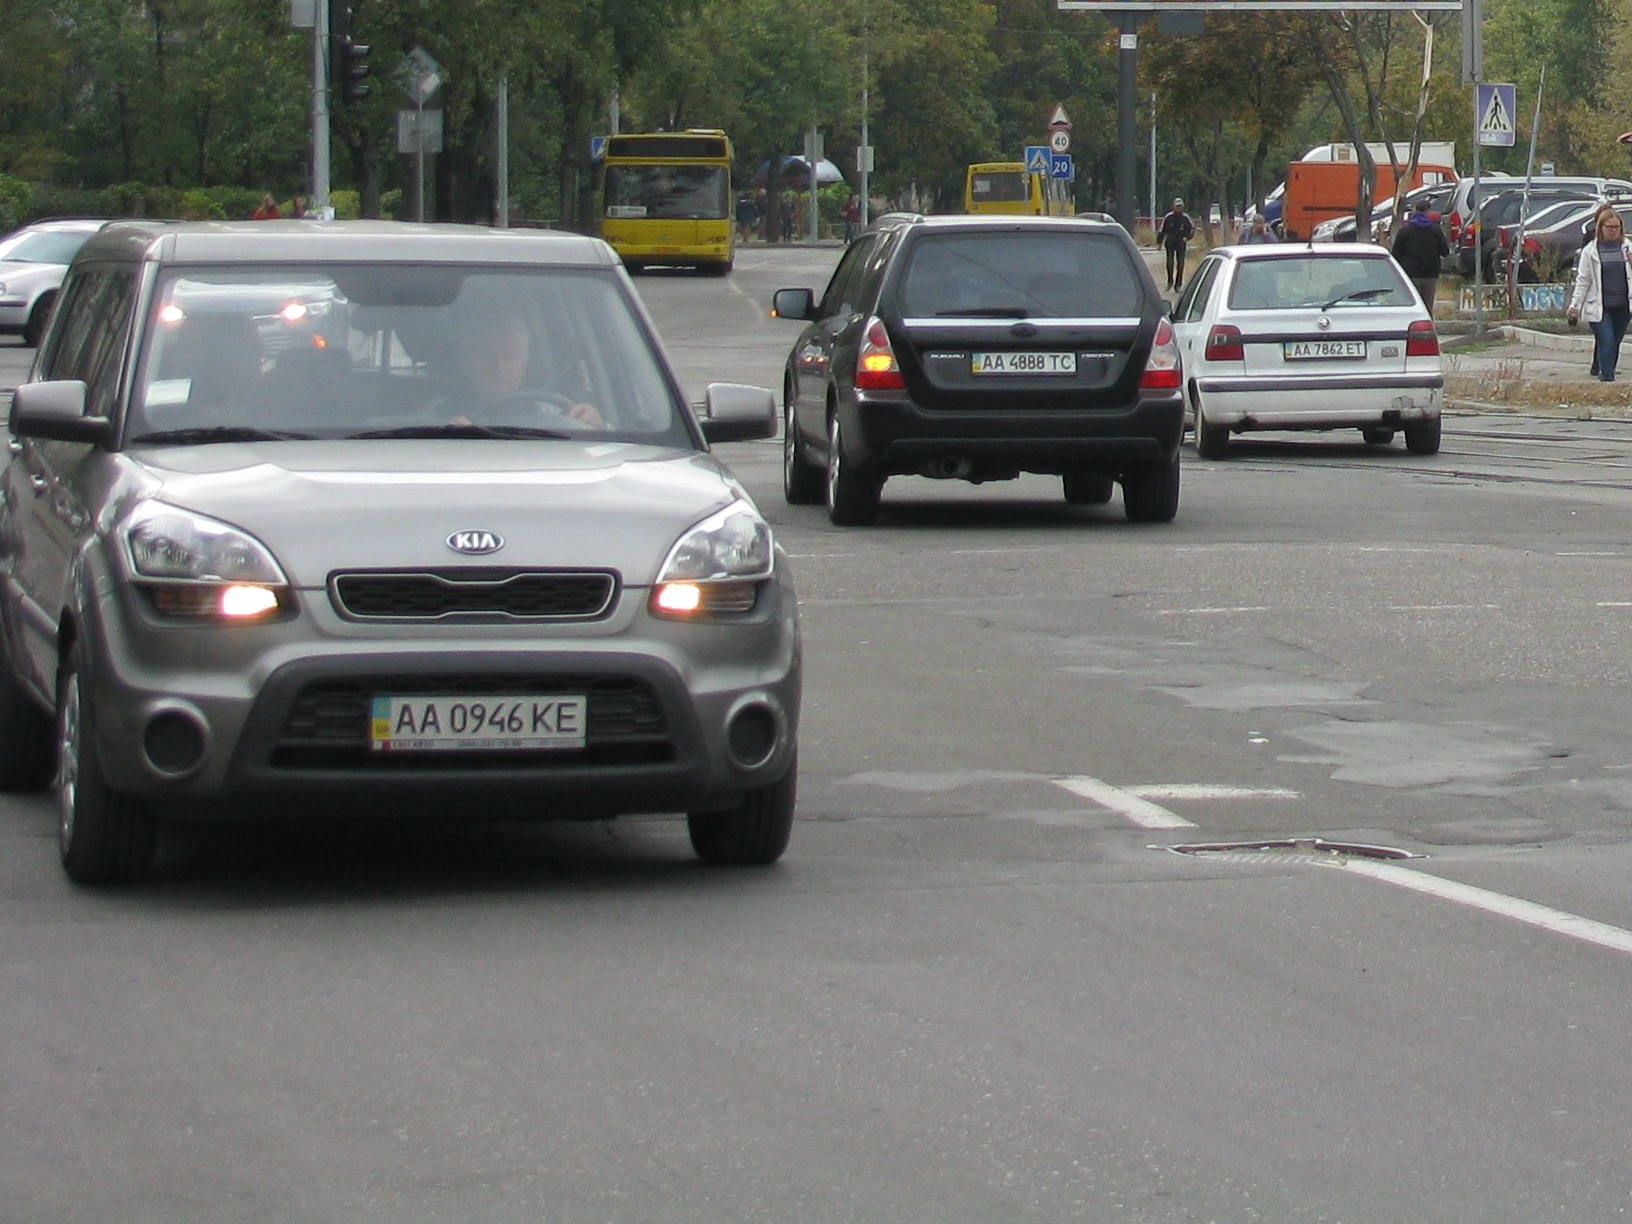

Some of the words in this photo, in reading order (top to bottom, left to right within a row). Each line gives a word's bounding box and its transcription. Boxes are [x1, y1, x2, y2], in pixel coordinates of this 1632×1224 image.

[1054, 137, 1067, 147] 40
[1054, 162, 1068, 175] 20
[1294, 343, 1311, 357] AA
[1315, 342, 1343, 356] 7862
[1346, 342, 1362, 355] ET
[982, 354, 1005, 370] AA
[1009, 354, 1045, 370] 4888
[1049, 354, 1072, 370] TC
[456, 532, 497, 549] KIA
[395, 703, 442, 734] AA
[449, 702, 524, 734] 0946
[531, 702, 579, 734] KE
